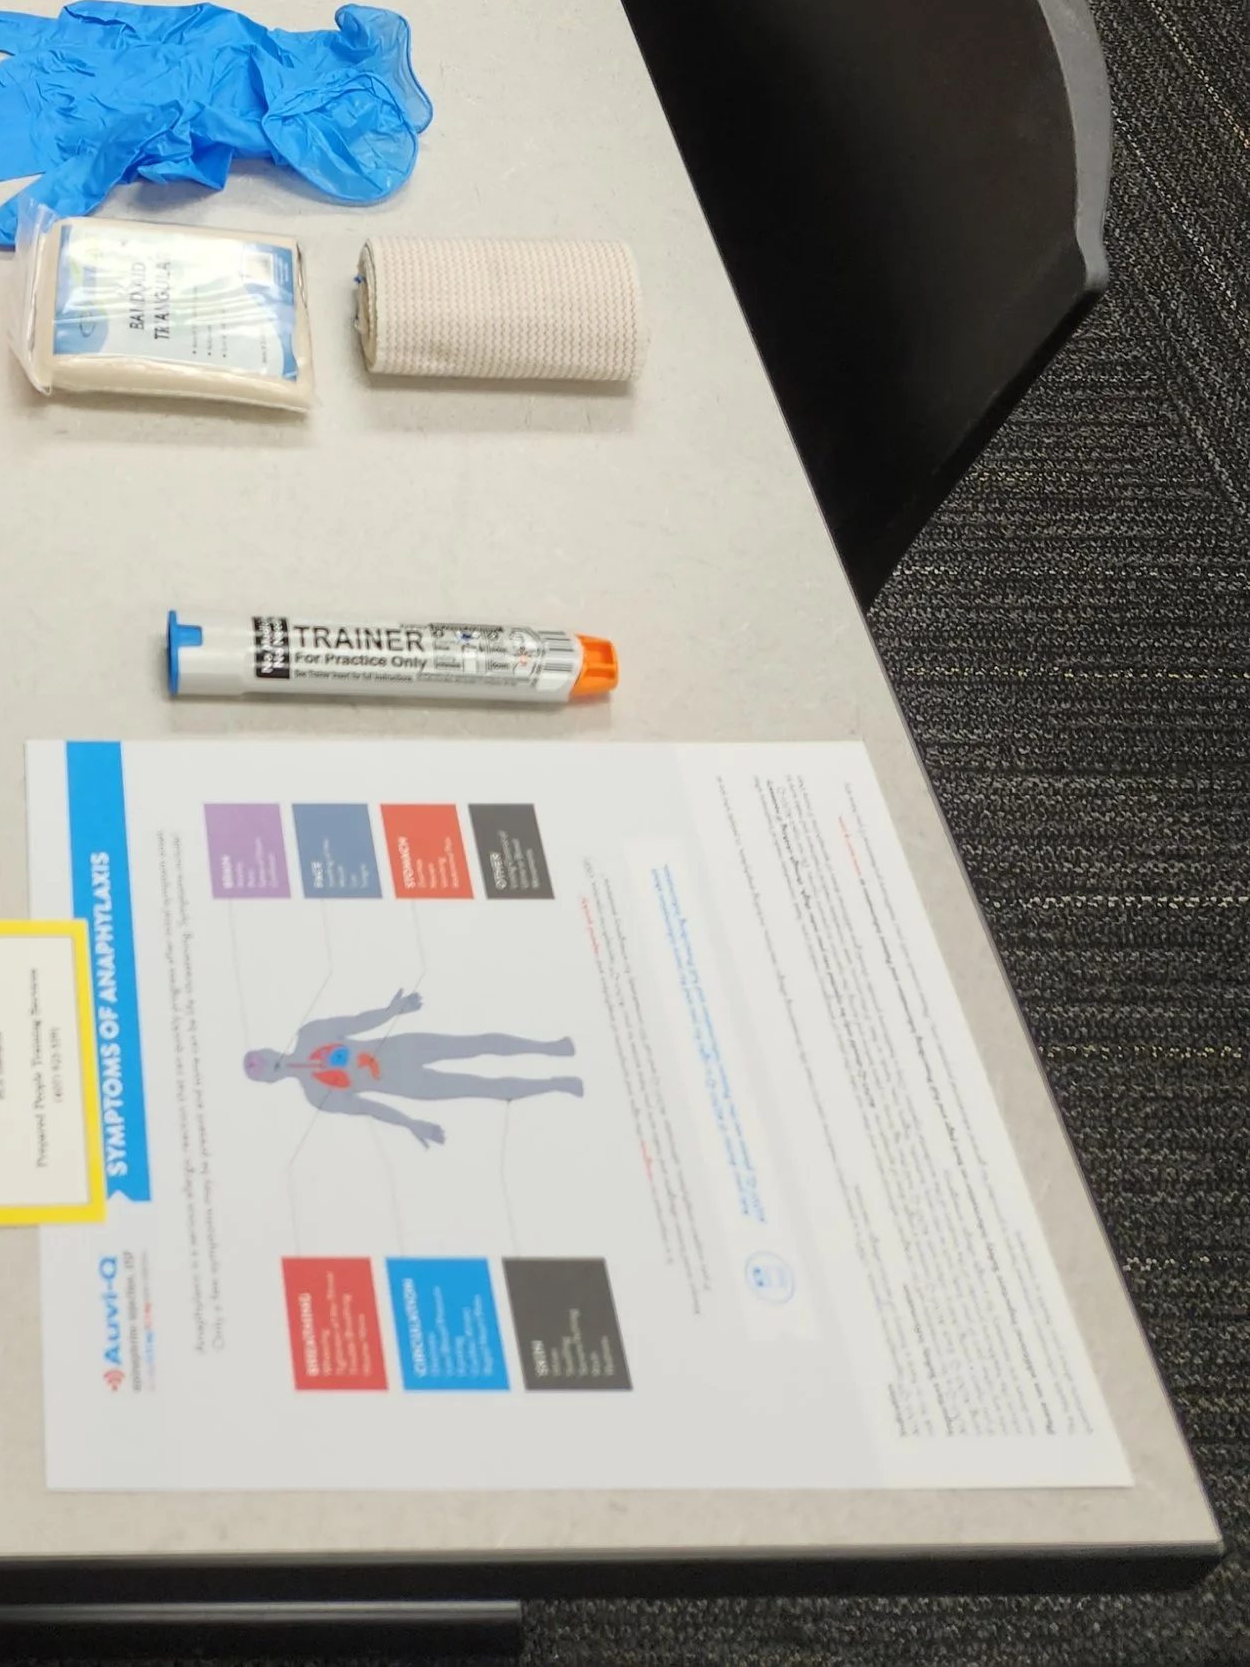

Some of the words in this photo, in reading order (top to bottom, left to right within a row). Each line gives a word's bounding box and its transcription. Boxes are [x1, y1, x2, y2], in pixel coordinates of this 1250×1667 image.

[293, 625, 425, 652] TRAINER
[295, 651, 321, 664] For
[324, 653, 388, 668] Practice
[391, 655, 428, 672] Only
[89, 851, 119, 1004] ANAPHYLAXIS
[97, 1006, 121, 1040] OF
[100, 1043, 129, 1177] SYMPTOMS
[98, 1256, 122, 1366] Auvi-Q
